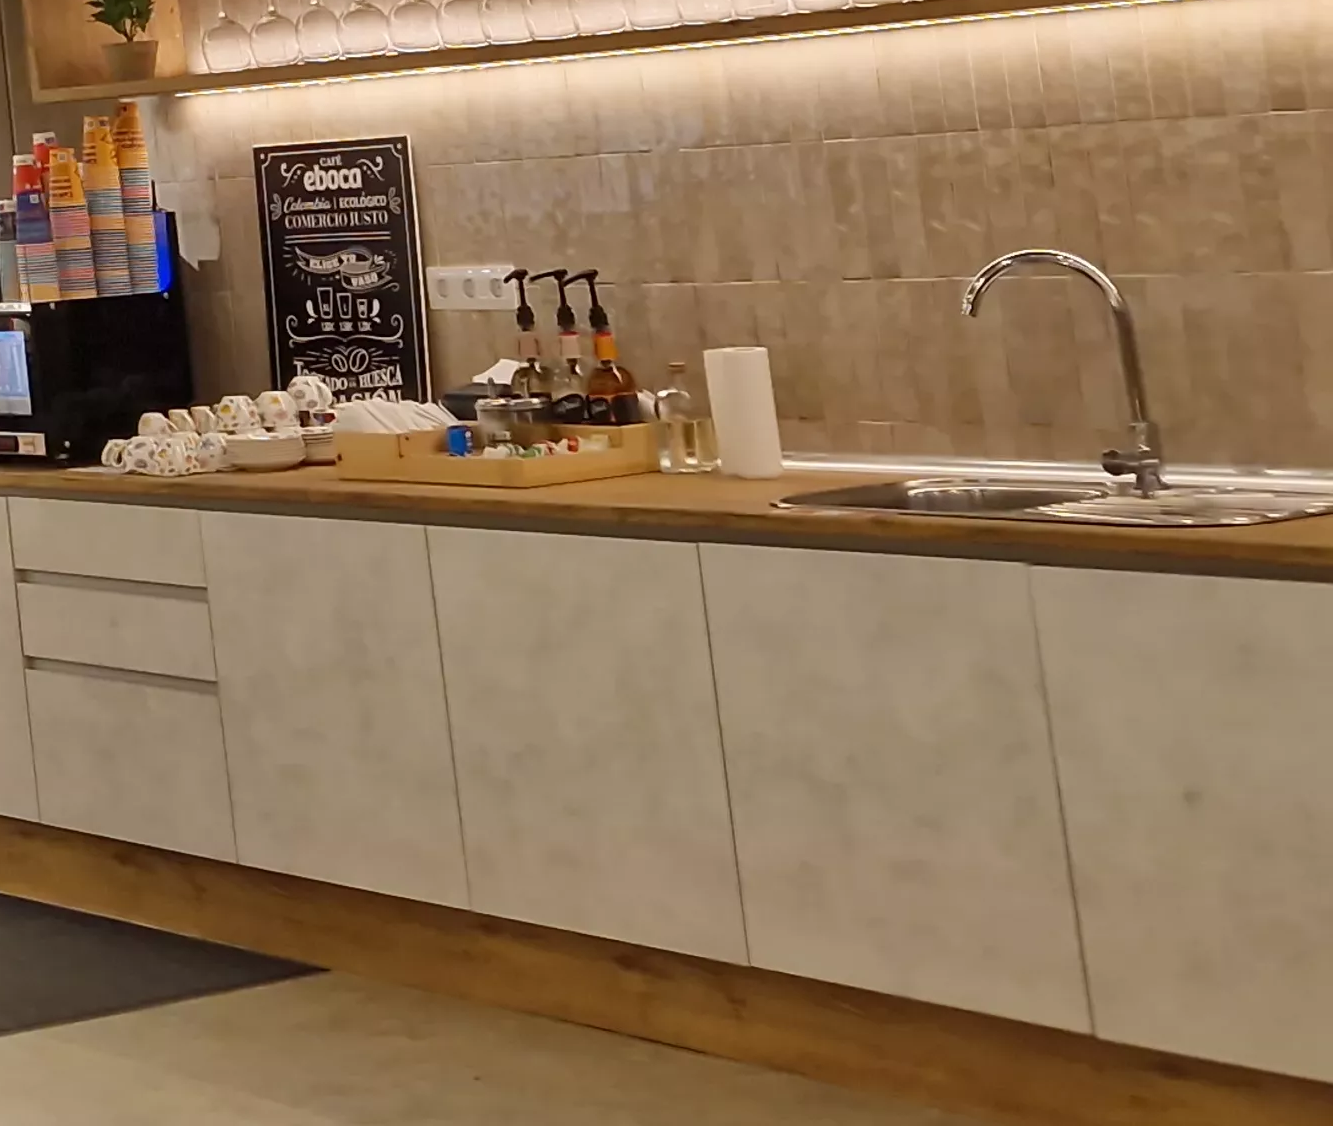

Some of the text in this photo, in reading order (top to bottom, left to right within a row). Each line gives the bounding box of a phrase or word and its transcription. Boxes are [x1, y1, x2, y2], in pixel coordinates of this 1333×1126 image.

[303, 164, 363, 191] eboca
[338, 191, 387, 209] ECOLÓGICO
[285, 210, 389, 229] COMERCIO JUSTO
[359, 364, 403, 388] HUESCA
